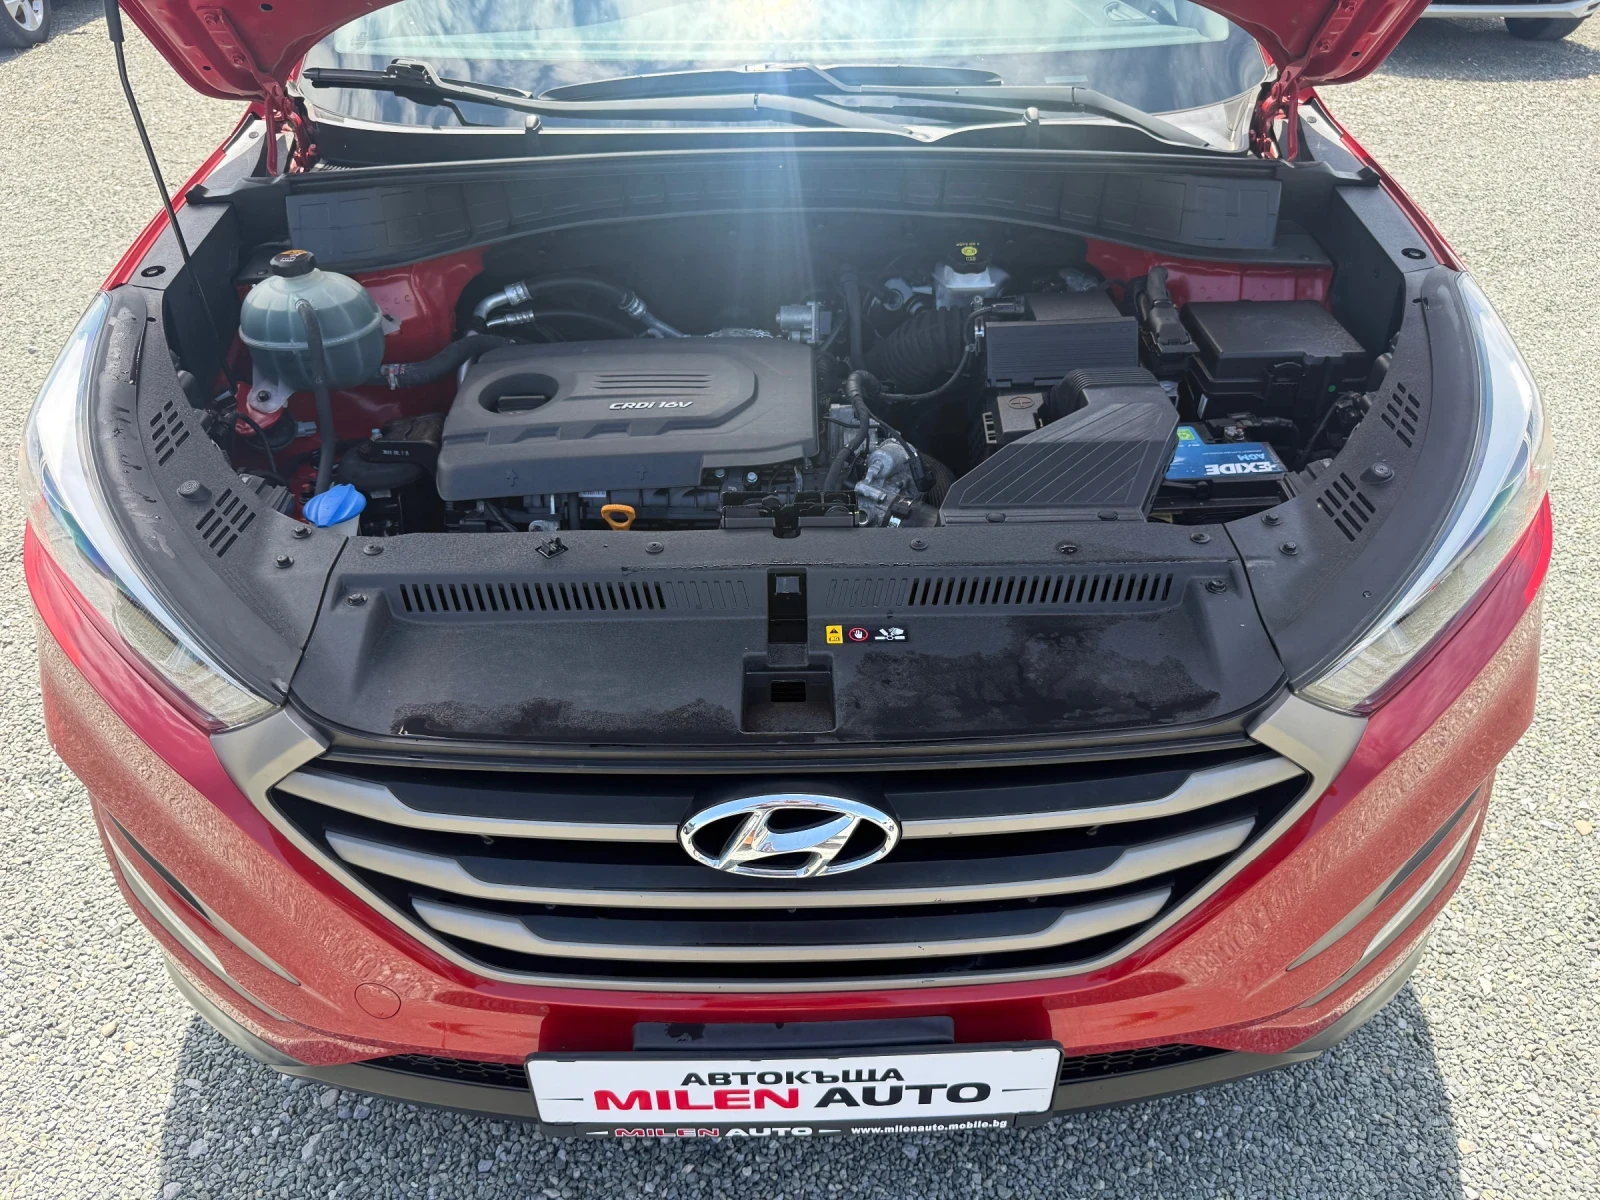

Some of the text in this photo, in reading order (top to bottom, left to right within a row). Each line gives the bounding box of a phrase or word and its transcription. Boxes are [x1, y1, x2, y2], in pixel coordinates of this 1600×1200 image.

[609, 401, 656, 410] CRDi
[1205, 462, 1274, 475] EXIDE
[680, 1068, 905, 1086] АВТОКЪША
[593, 1082, 991, 1111] MILEN AUTO
[614, 1126, 813, 1138] MILEN AUTO
[851, 1119, 1008, 1135] www.milenauto.mobile.bg
